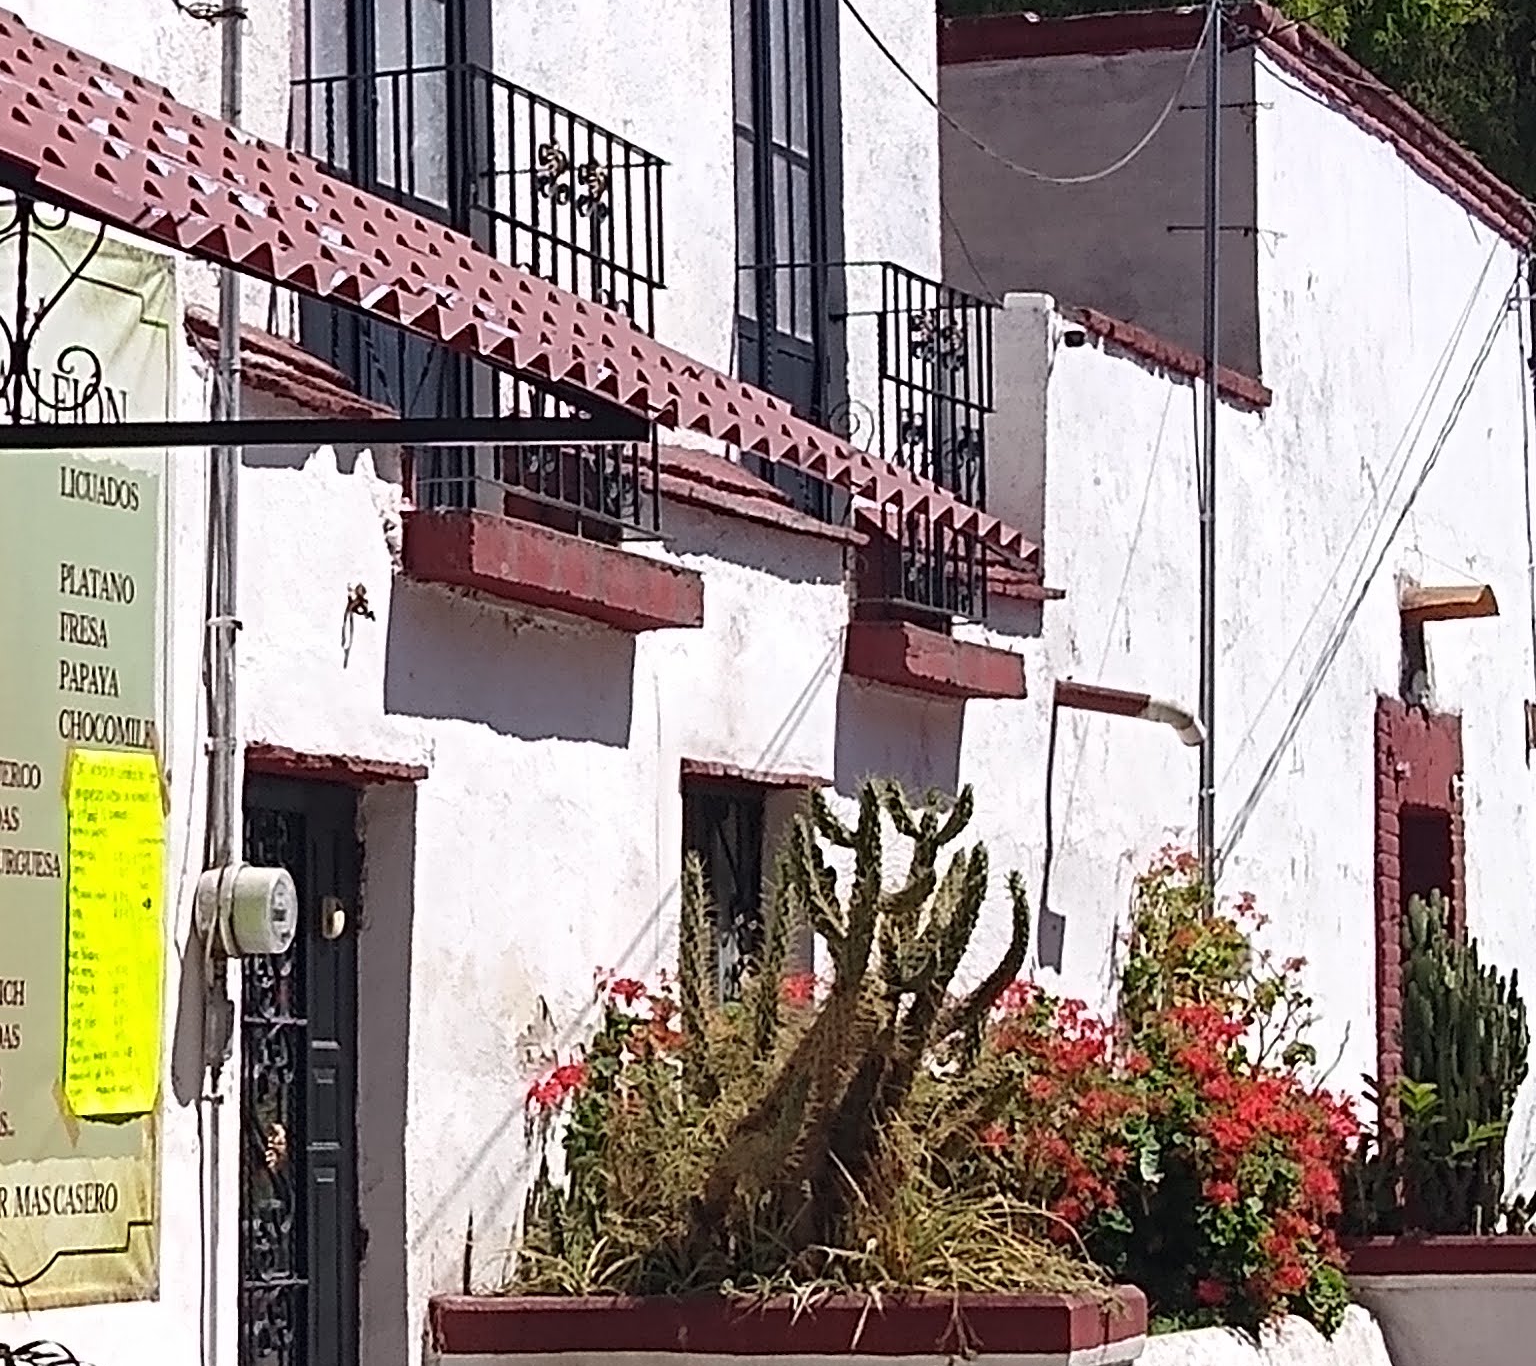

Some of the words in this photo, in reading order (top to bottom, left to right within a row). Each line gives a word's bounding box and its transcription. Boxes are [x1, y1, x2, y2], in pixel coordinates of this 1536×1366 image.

[61, 466, 139, 511] LICUADOS
[60, 563, 135, 604] PLATANO
[59, 611, 109, 649] FRESA
[59, 659, 119, 697] PAPAYA
[14, 1185, 51, 1217] MAS
[53, 1182, 119, 1215] CASERO
